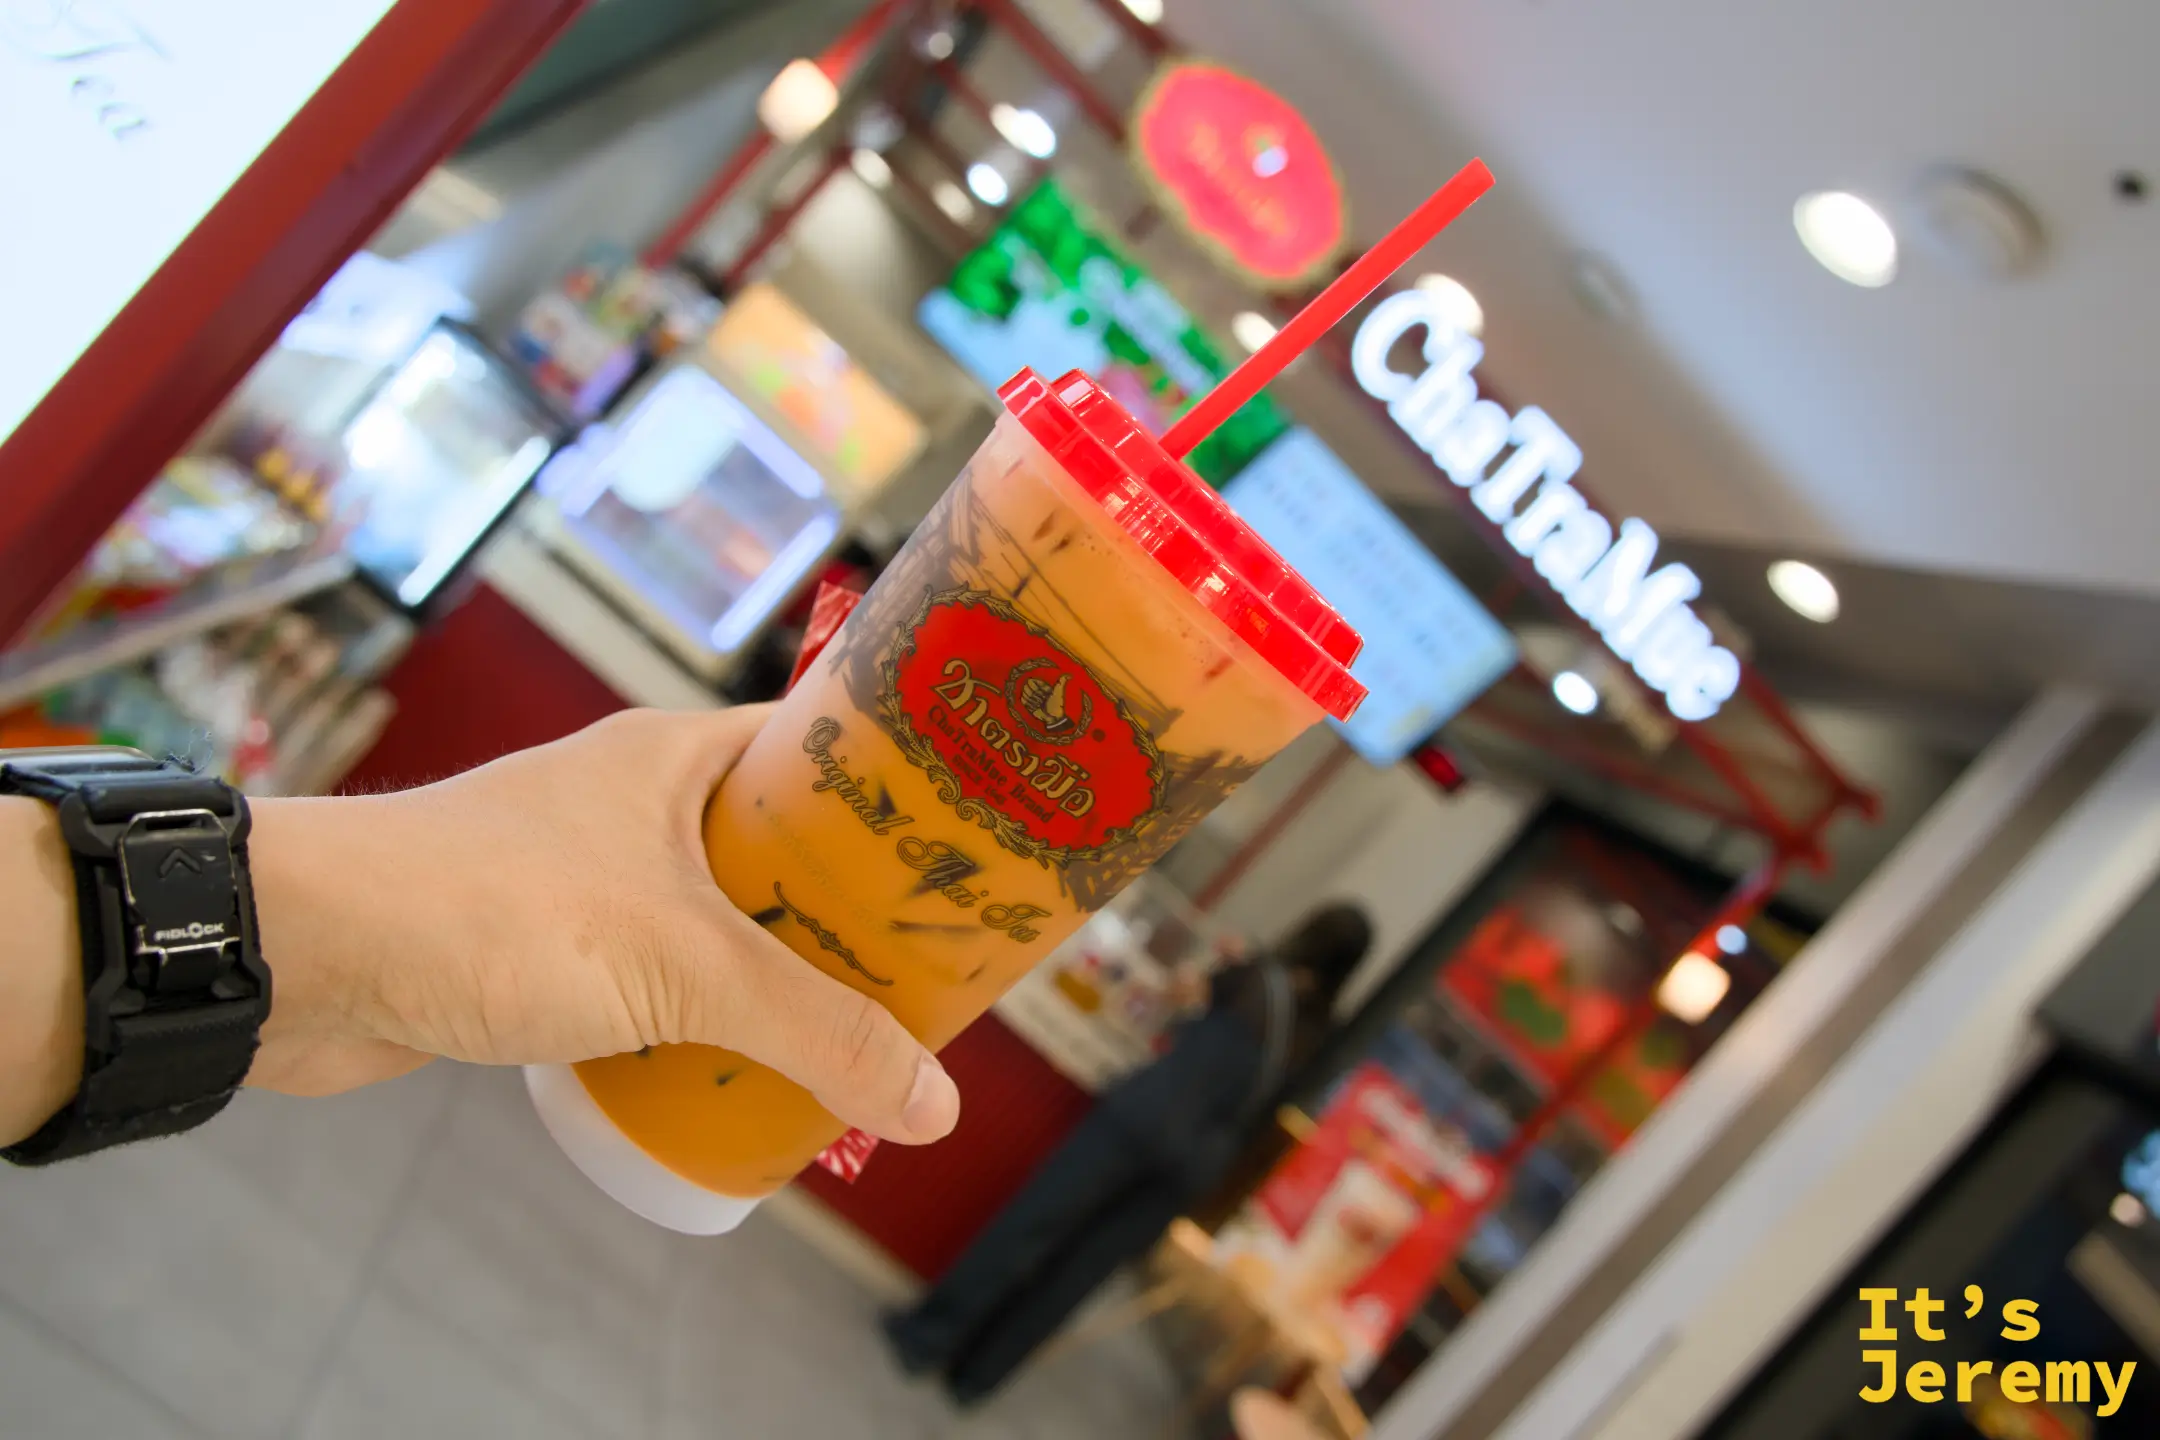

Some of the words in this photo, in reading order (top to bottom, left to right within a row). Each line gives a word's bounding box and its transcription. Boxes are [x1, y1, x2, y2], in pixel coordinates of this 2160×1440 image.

[1352, 288, 1741, 722] ChaTraMue
[927, 704, 1010, 788] ChaTraMue
[1009, 783, 1060, 824] Brand
[930, 658, 1096, 819] ชาตรามือ
[803, 717, 914, 835] Original
[896, 837, 989, 908] Thai
[980, 904, 1052, 944] Tea
[154, 922, 225, 941] FIDLOCK
